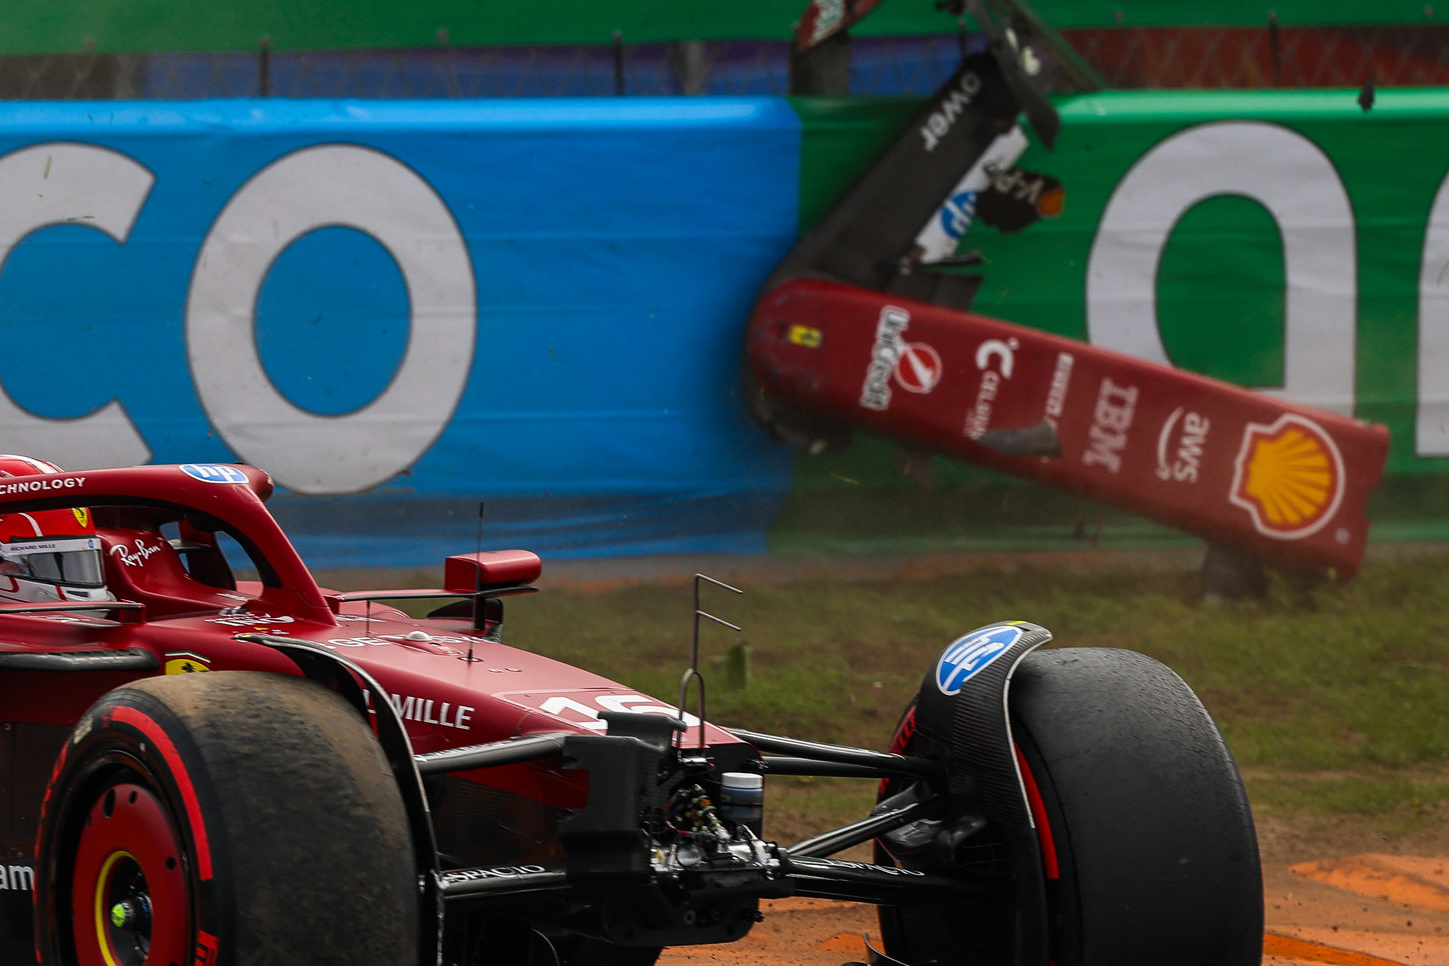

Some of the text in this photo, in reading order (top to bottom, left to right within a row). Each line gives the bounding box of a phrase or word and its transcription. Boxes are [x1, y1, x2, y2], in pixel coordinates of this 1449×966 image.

[1084, 118, 1449, 458] a
[1082, 378, 1139, 473] IBM
[1172, 411, 1210, 484] aws
[184, 464, 243, 484] hp
[392, 694, 476, 731] MILLE
